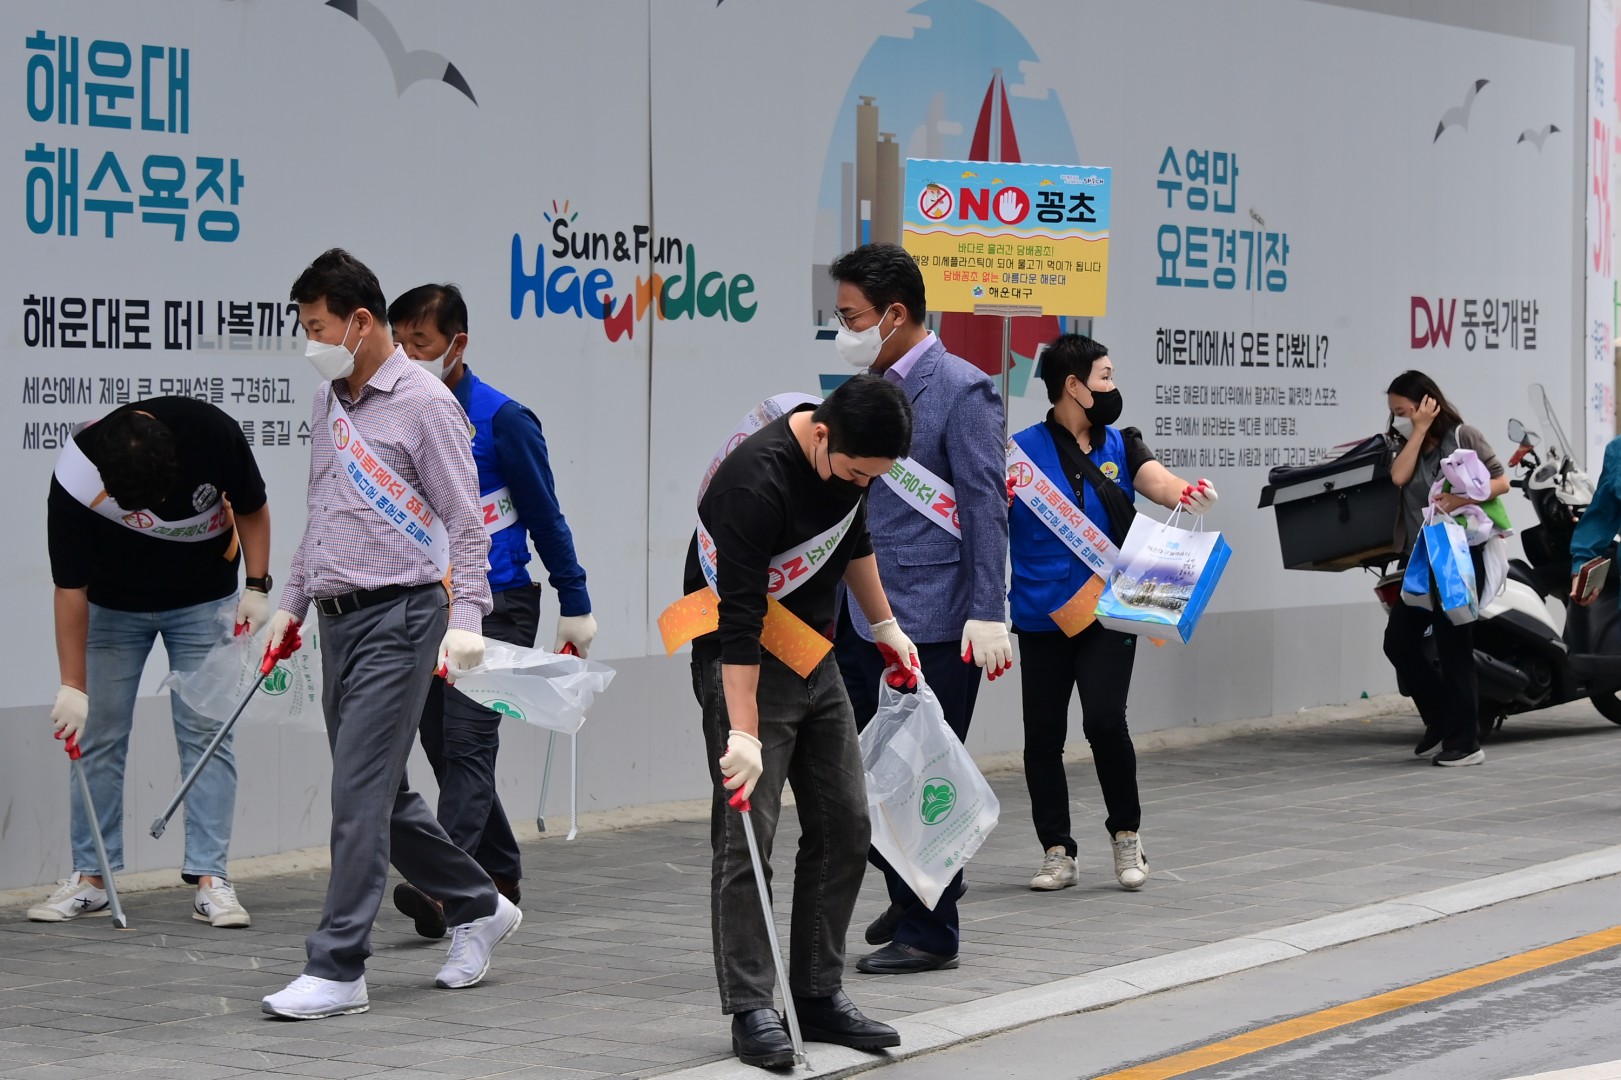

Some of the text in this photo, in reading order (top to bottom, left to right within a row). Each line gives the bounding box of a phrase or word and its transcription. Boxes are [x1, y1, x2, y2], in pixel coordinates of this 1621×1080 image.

[25, 29, 190, 134] 해운대
[25, 142, 244, 243] 해수욕장
[1156, 146, 1239, 214] 수영만
[1035, 190, 1097, 223] 꽁초
[932, 255, 994, 269] 미세플라스틱이
[997, 258, 1014, 270] 되어
[1017, 258, 1043, 271] 물고기
[1046, 259, 1073, 272] 먹이가
[1075, 260, 1102, 273] 됩니다
[958, 242, 1054, 257] 바다로 흘러간 담배꽁초!
[1156, 224, 1290, 292] 요트경기장
[510, 233, 758, 342] Haeundae
[943, 270, 1066, 286] 담배꽁초 없는 아름다운 해운대
[988, 286, 1033, 299] 해운대구
[22, 293, 301, 351] 해운대로 떠나볼까?
[1411, 296, 1457, 349] DW
[1461, 298, 1539, 351] 동원개발
[1156, 327, 1329, 369] 해운대에서 요트 타봤나?
[22, 376, 92, 405] 세상에서
[99, 377, 130, 405] 제일
[160, 377, 224, 404] 모래성을
[1155, 385, 1181, 405] 드넓은
[1183, 385, 1209, 406] 해운대
[1210, 386, 1252, 406] 바다위에서
[1254, 386, 1286, 406] 펼쳐지는
[1288, 386, 1313, 407] 짜릿한
[262, 420, 290, 446] 즐길
[1155, 416, 1172, 436] 요트
[1175, 416, 1200, 436] 위에서
[1202, 416, 1236, 437] 바라보는
[1238, 417, 1262, 436] 색다른
[1154, 448, 1197, 467] 해운대에서
[1199, 448, 1216, 467] 하나
[1218, 448, 1236, 467] 되는
[1238, 447, 1262, 467] 사람과
[1264, 447, 1281, 467] 바다
[1282, 447, 1306, 466] 그리고
[347, 461, 379, 500] 아름다운
[375, 495, 408, 525] 해운대
[349, 439, 434, 528] 담배꽁초 없는
[888, 461, 937, 505] 배꽁초
[1030, 496, 1062, 528] 아름다운
[1058, 523, 1084, 549] 해운대
[1034, 479, 1110, 553] 담배꽁초 없는
